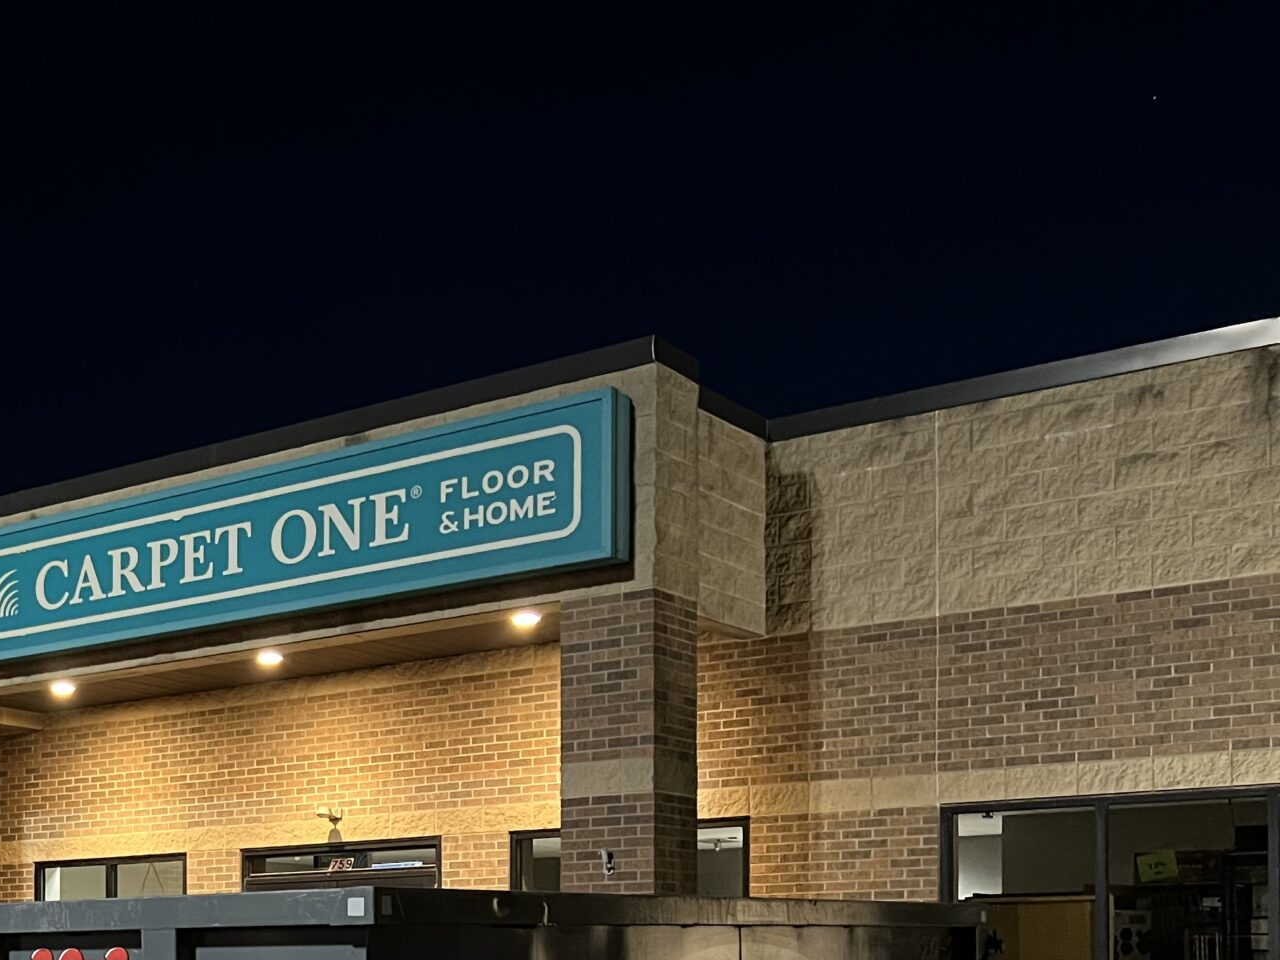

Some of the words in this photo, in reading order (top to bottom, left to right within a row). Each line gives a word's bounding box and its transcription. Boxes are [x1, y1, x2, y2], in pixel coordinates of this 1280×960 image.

[440, 459, 556, 503] FLOOR
[439, 491, 557, 535] &HOME
[35, 521, 252, 610] CARPET
[271, 488, 410, 565] ONE
[331, 860, 353, 870] 759
